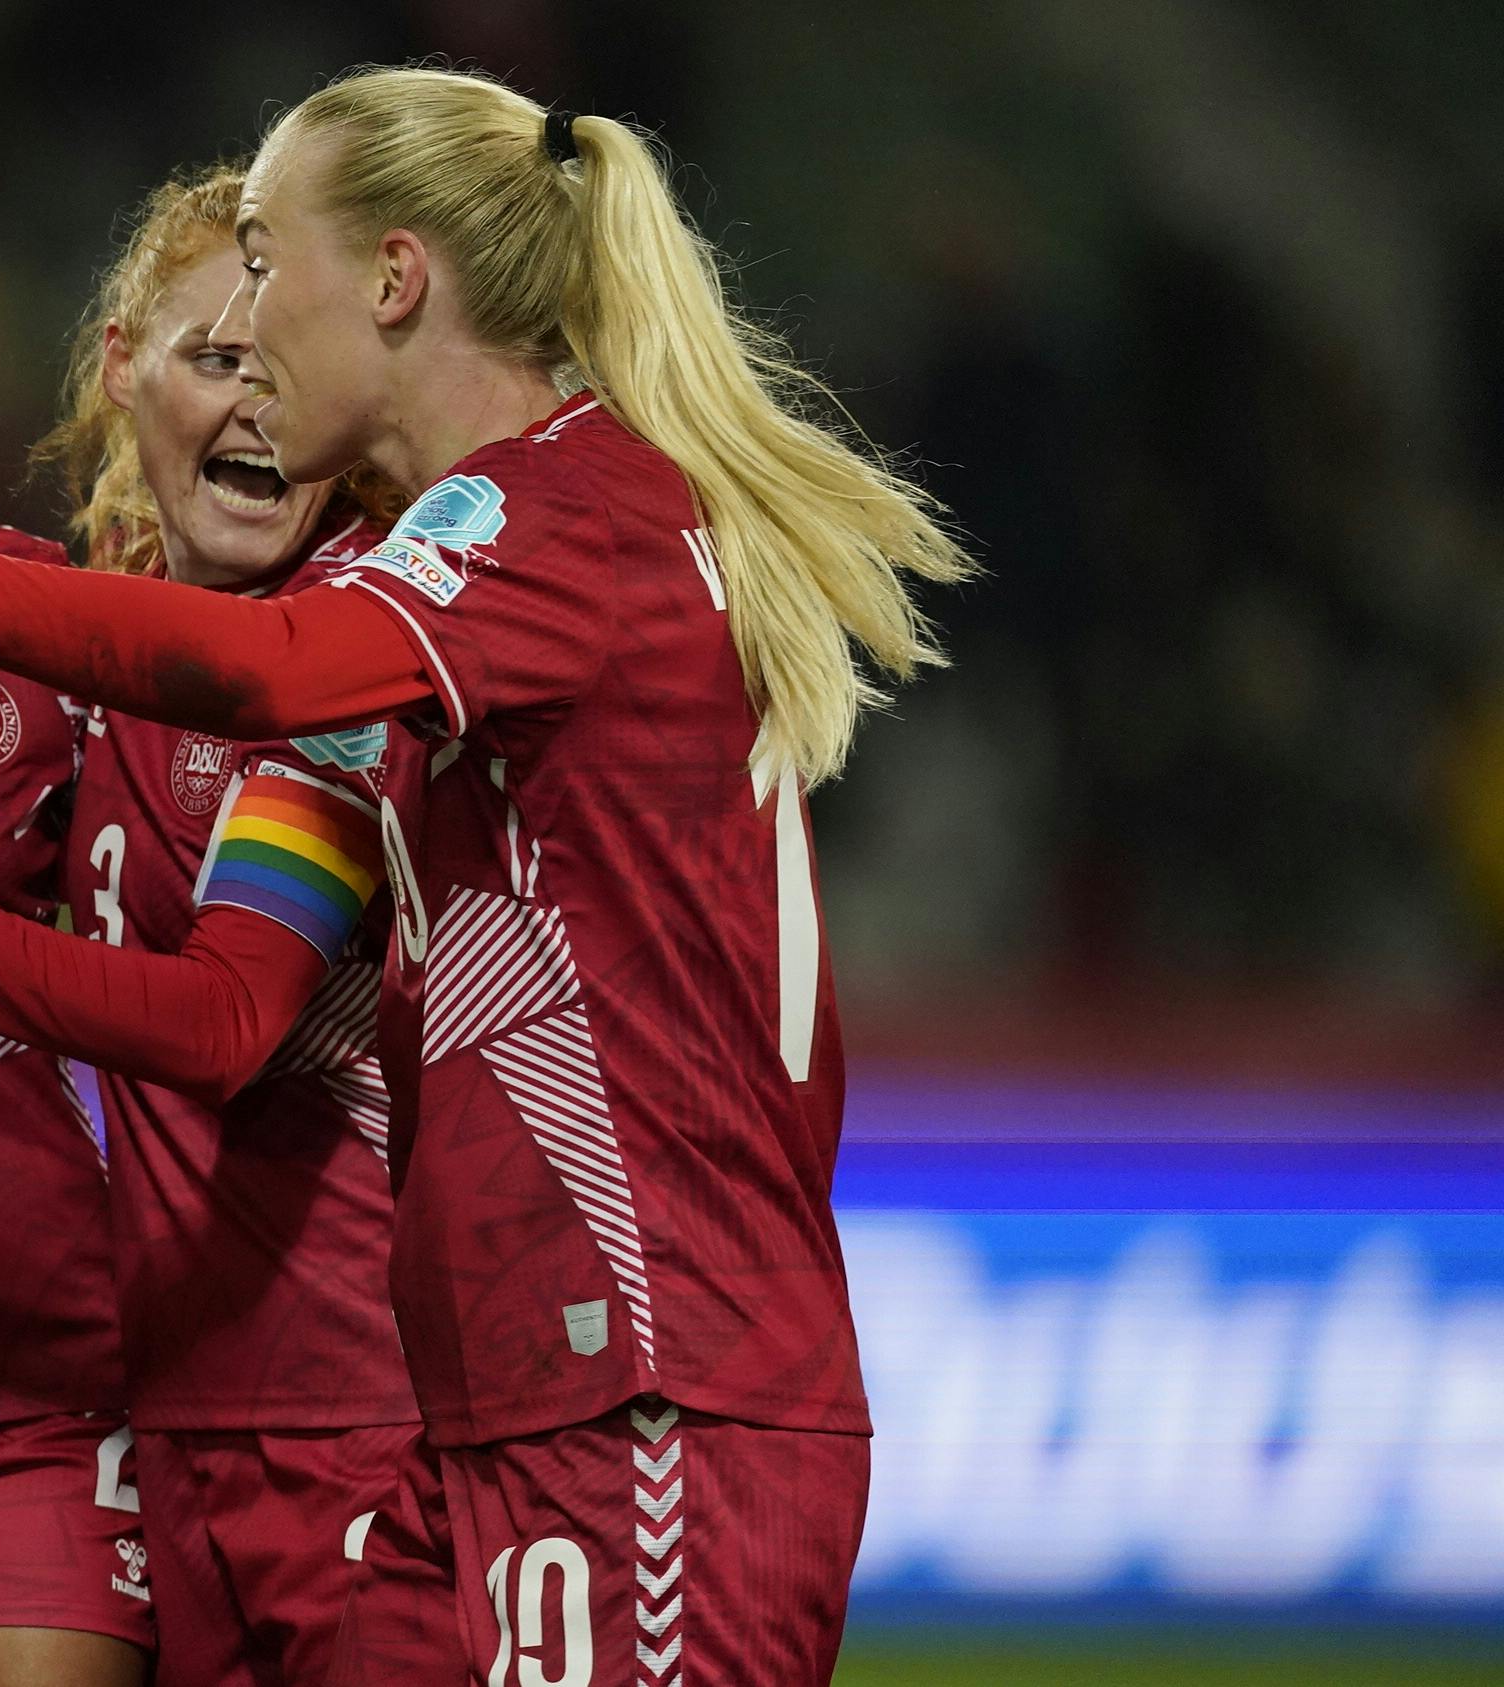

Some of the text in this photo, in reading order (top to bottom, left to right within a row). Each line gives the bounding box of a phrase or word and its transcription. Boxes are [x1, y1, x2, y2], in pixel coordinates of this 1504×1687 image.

[185, 743, 225, 774] DBU
[89, 824, 126, 947] 3
[486, 1537, 594, 1687] 10
